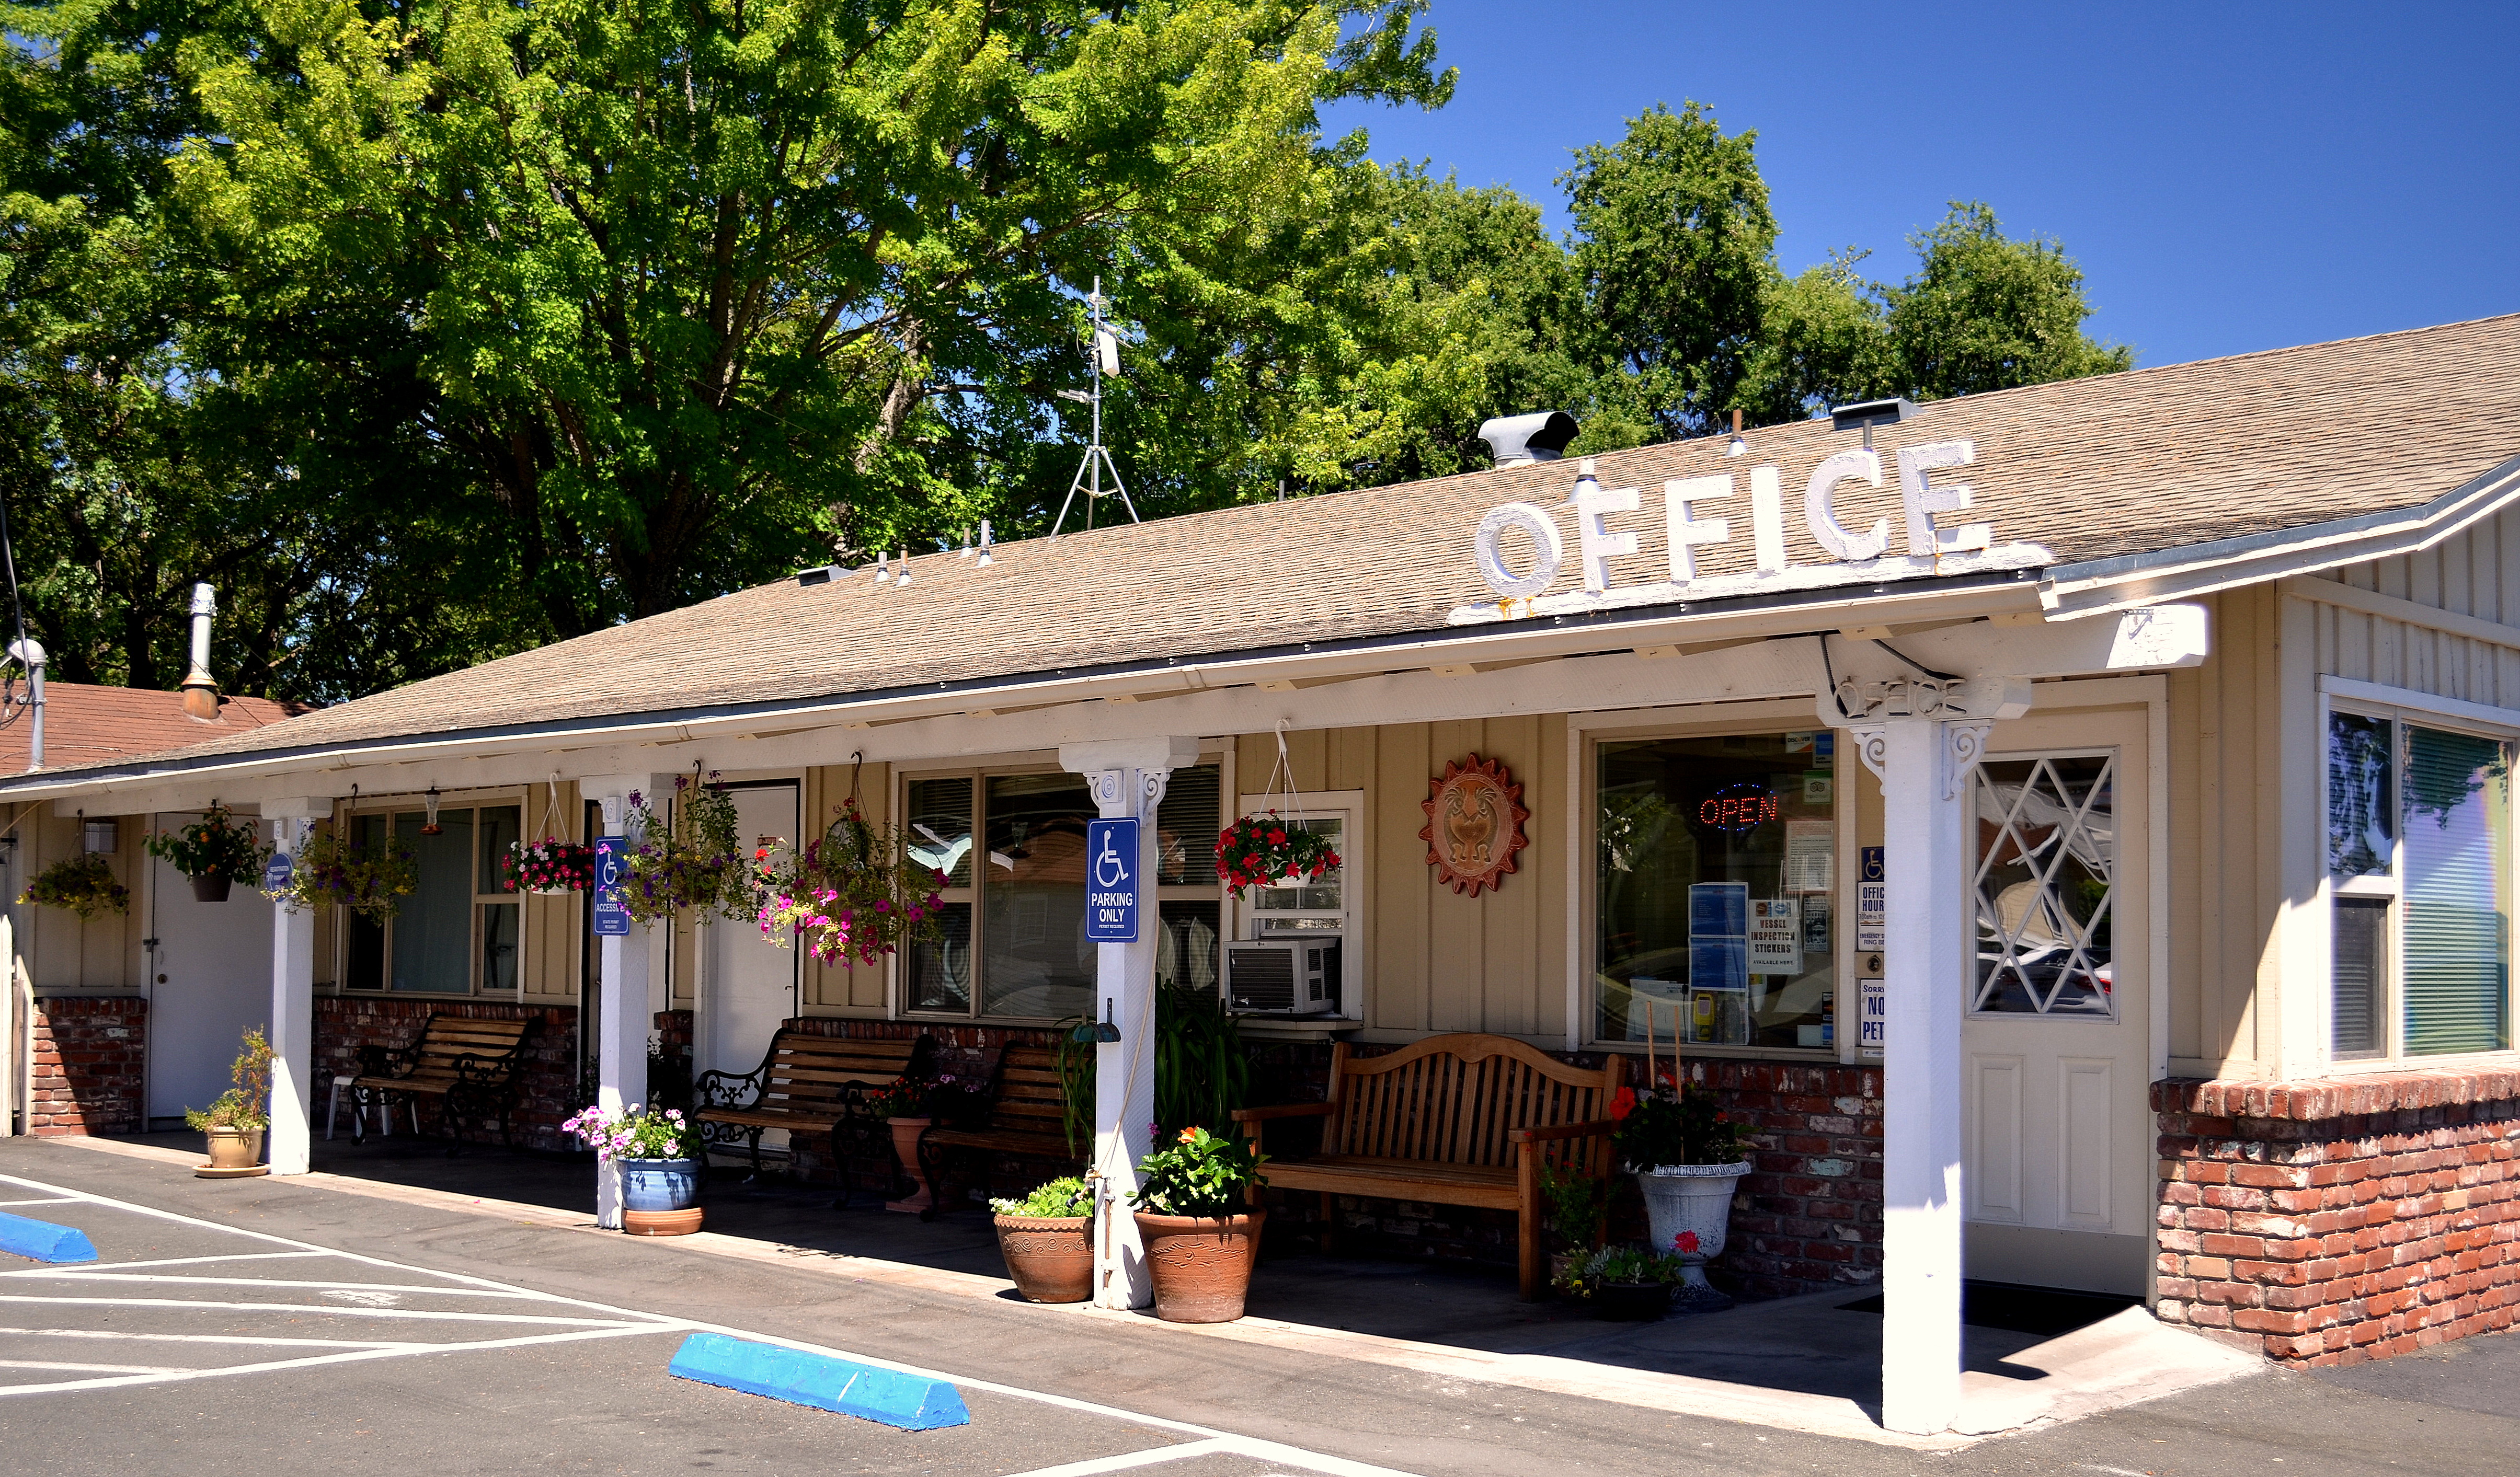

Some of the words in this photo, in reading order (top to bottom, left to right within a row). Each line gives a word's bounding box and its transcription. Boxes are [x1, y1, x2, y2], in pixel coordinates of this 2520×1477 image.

[1474, 440, 1990, 599] OFFICE
[1700, 796, 1777, 824] OPEN
[1091, 892, 1133, 906] PARKING
[1863, 887, 1885, 899] OFFIC
[596, 904, 626, 912] ACCESSI
[1862, 899, 1885, 911] HOUR
[1099, 908, 1125, 922] ONLY
[1760, 919, 1786, 928] VESSEL
[1751, 932, 1795, 941] INSPECTION
[1755, 944, 1791, 953] STICKERS
[1868, 996, 1885, 1016] NO
[1863, 1021, 1885, 1040] PET
